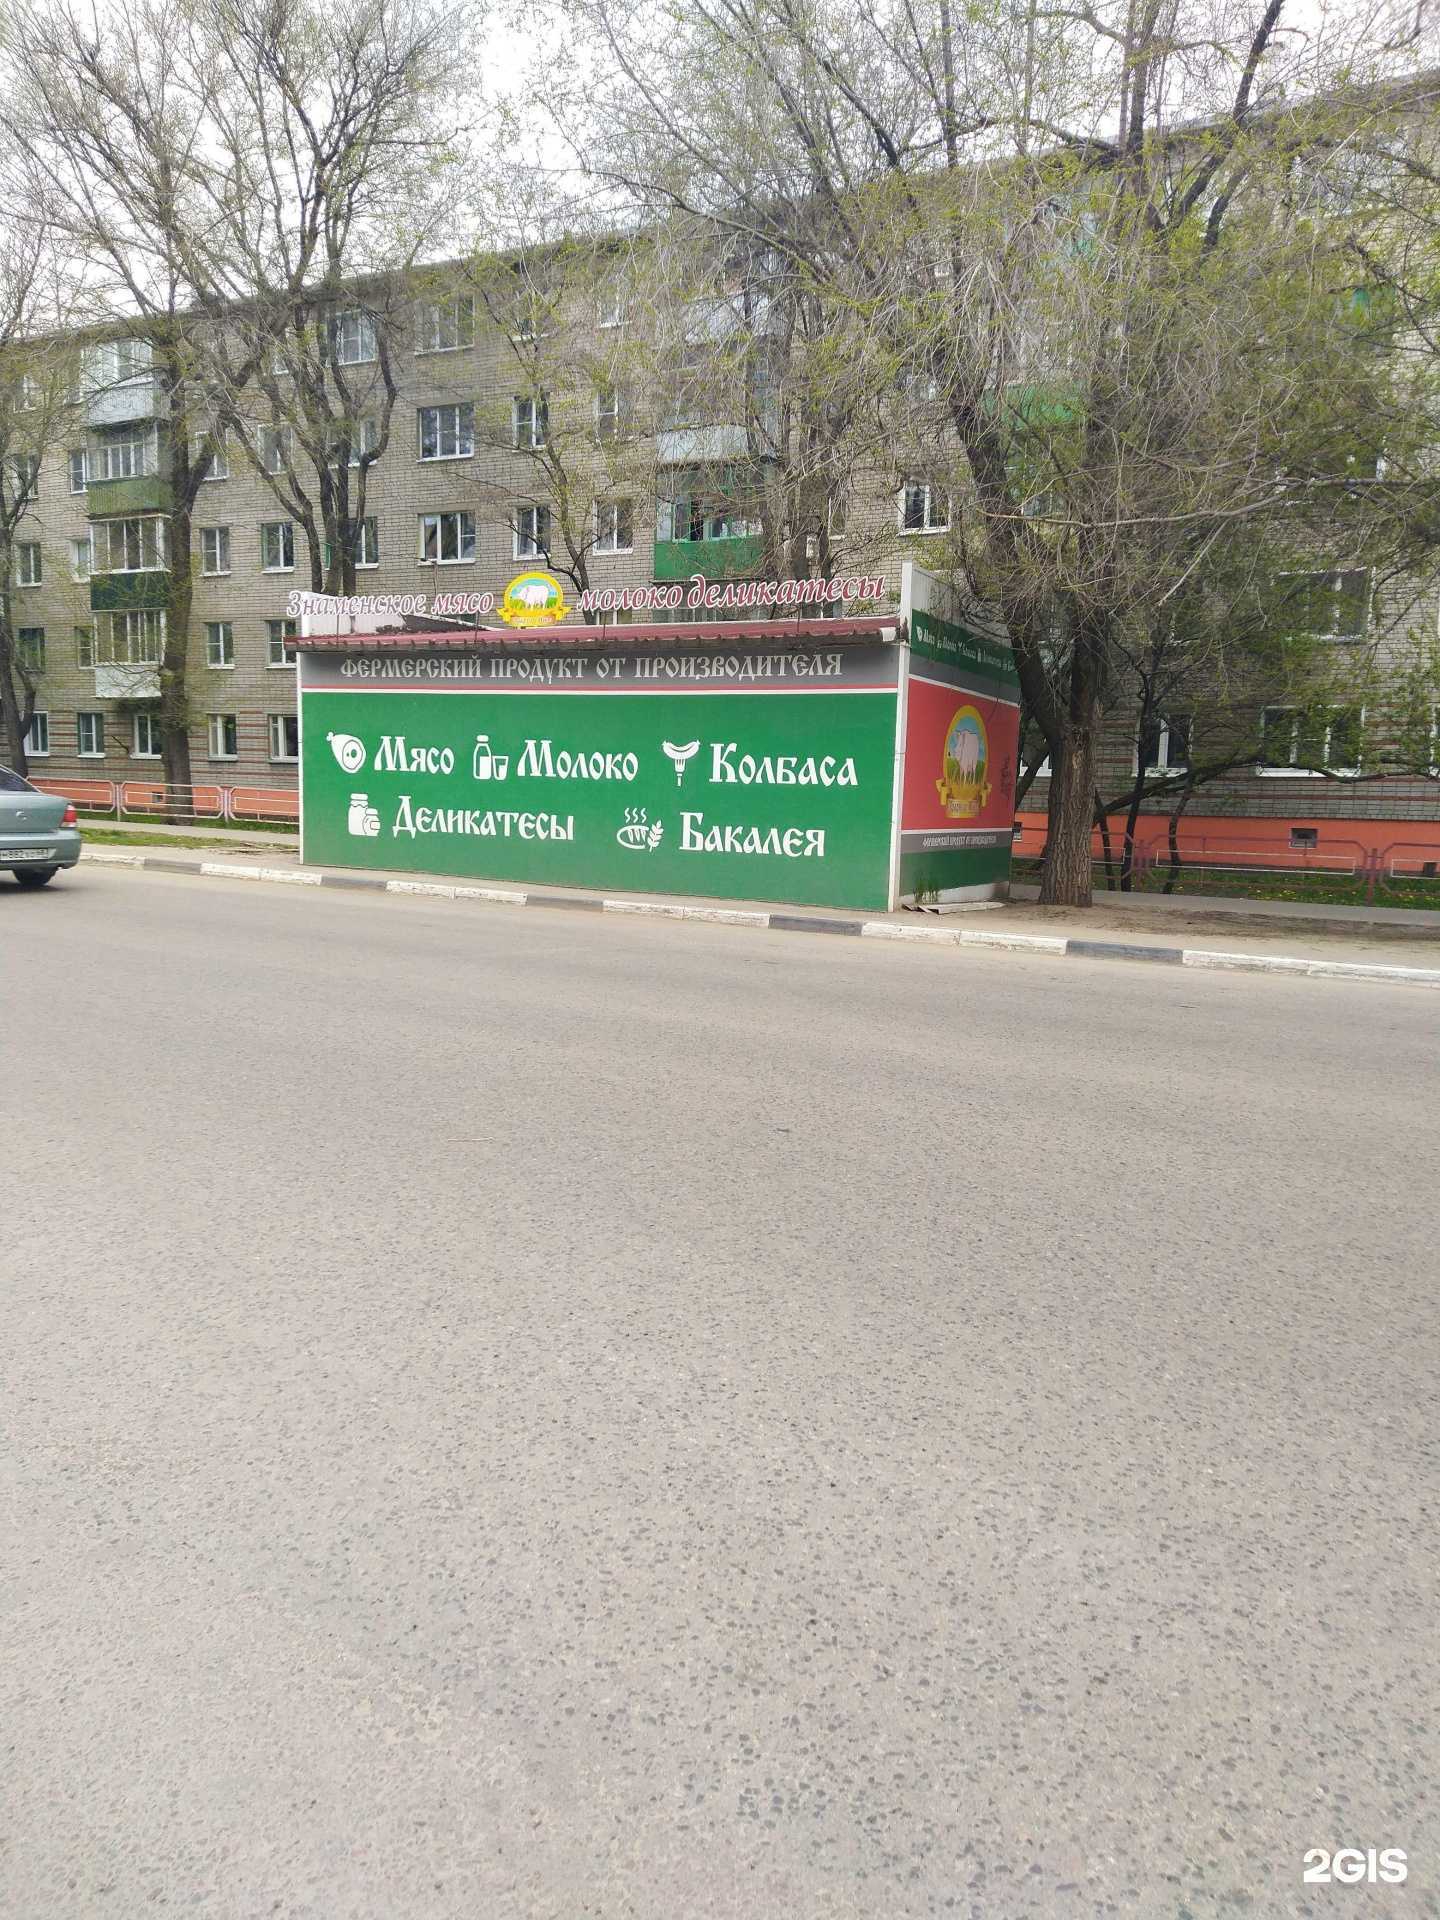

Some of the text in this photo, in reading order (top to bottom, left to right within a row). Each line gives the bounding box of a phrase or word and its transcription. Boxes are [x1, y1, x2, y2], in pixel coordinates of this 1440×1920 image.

[287, 574, 886, 617] Знаменское мясо молоко деликатесы
[340, 653, 843, 684] ФЕРМЕРСКИЙ ПРОДУКТ ОТ ПРОИЗВОДИТЕЛЯ
[374, 735, 858, 786] Мясо Молоко Колбаса
[392, 795, 825, 857] Деликатесы Бакалея
